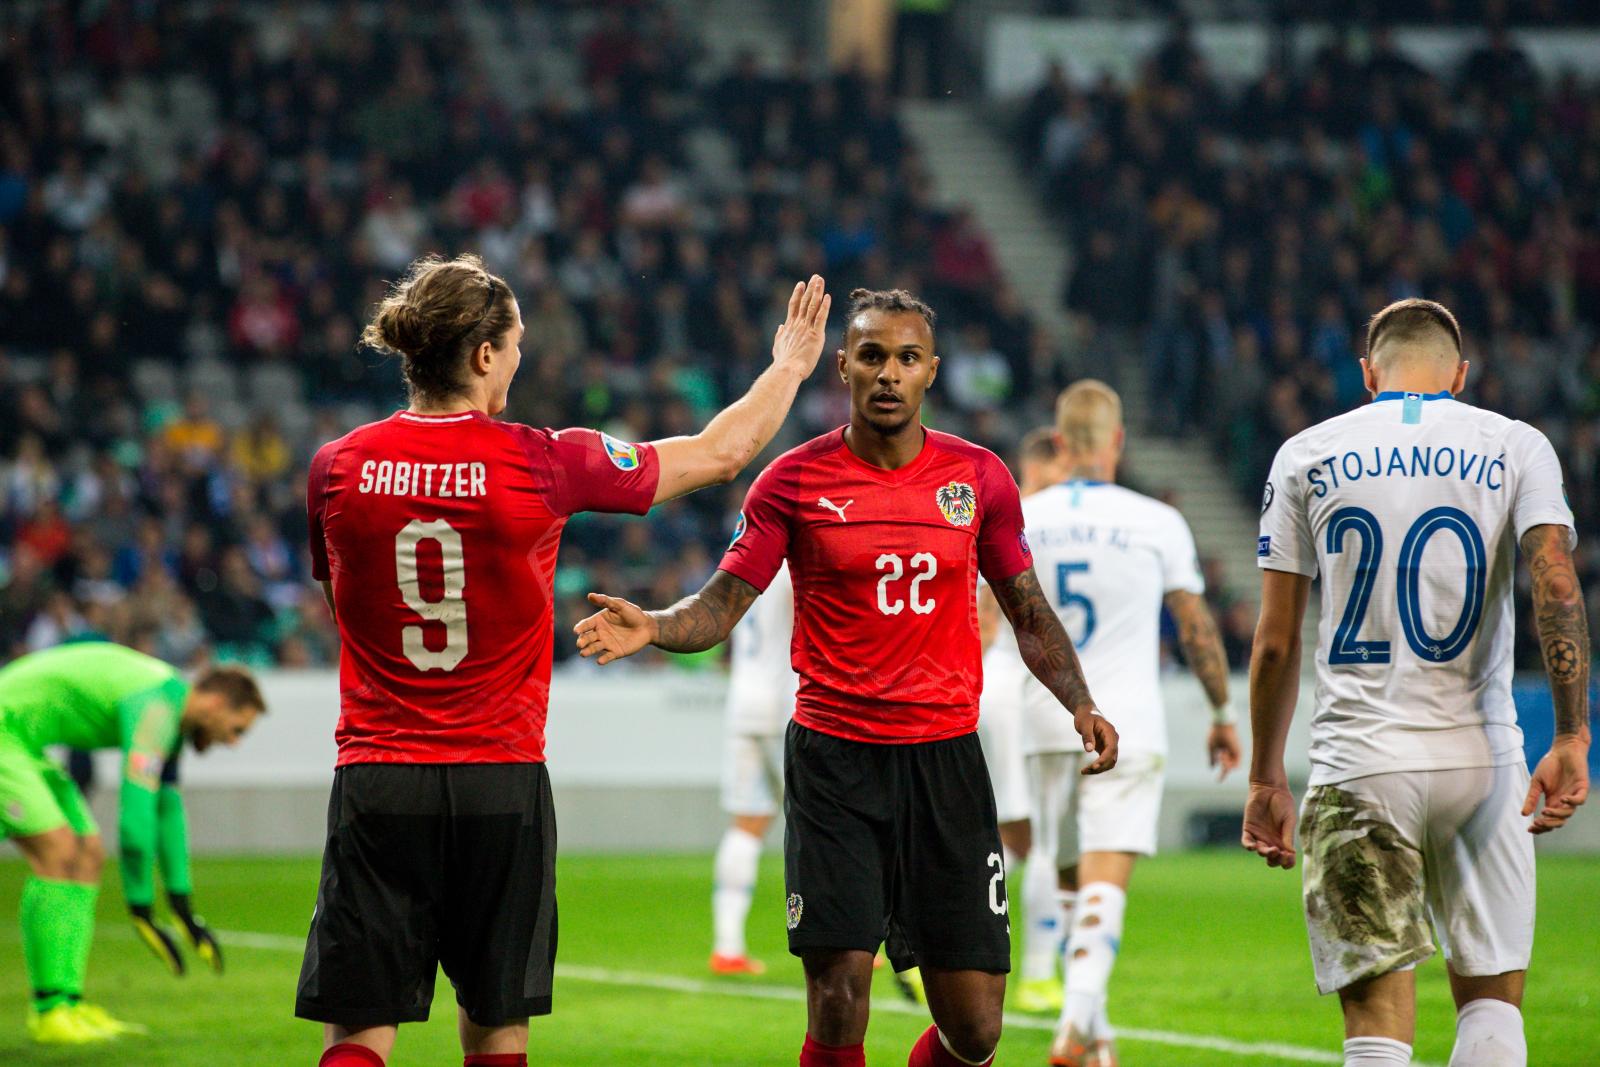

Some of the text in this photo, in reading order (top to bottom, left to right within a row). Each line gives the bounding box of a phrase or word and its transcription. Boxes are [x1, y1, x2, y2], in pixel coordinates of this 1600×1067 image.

[359, 460, 487, 497] SABITZER
[1307, 446, 1506, 498] STOJANOVIĆ
[395, 518, 469, 672] 9
[875, 552, 938, 616] 22
[1056, 560, 1097, 651] 5
[1326, 506, 1487, 665] 20
[987, 852, 1009, 916] 2
